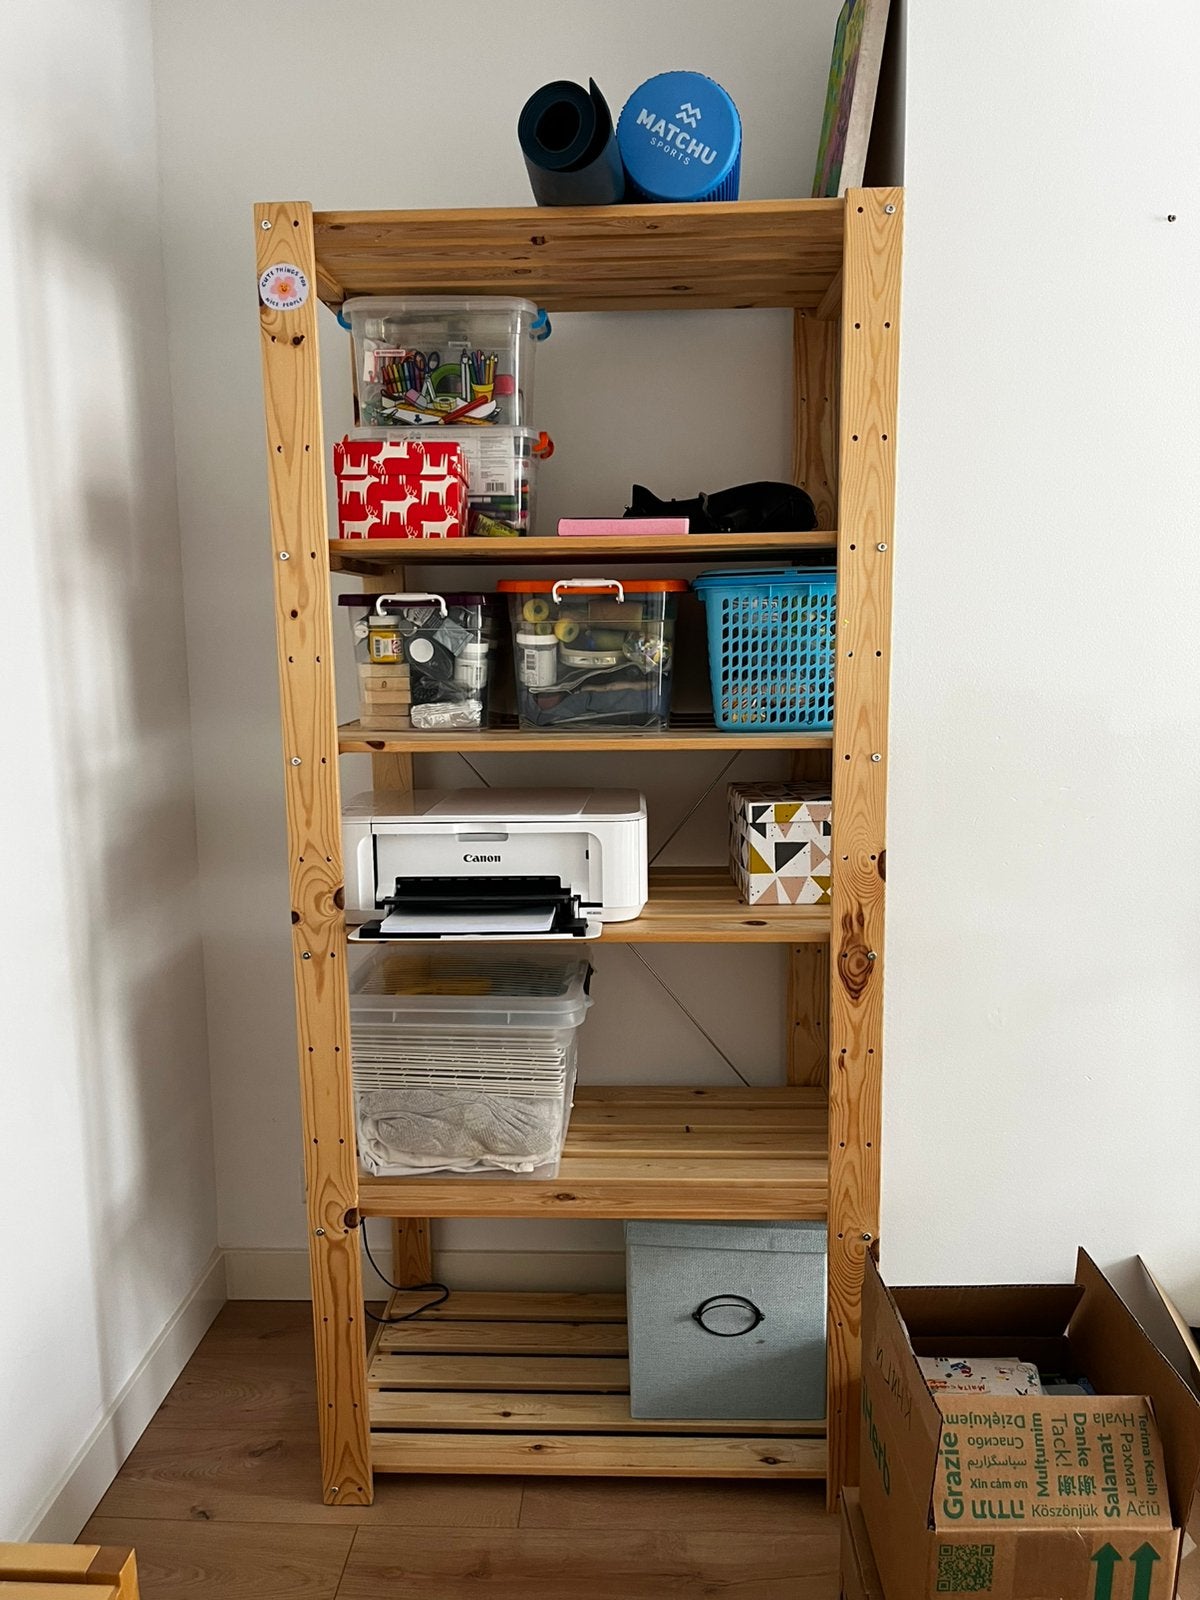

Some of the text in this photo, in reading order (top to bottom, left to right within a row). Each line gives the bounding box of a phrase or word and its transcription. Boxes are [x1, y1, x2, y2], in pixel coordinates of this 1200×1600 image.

[636, 108, 718, 165] MATCHU
[650, 137, 690, 166] SPORTS
[463, 854, 501, 862] Canon
[943, 1412, 1025, 1429] Dziękujem
[1093, 1412, 1134, 1427] Hvala
[967, 1436, 1024, 1449] Спасибо
[1051, 1413, 1072, 1467] Tack!
[1073, 1413, 1091, 1467] Danke
[1120, 1433, 1137, 1497] Рахмат
[1138, 1413, 1158, 1496] Terima Kasih
[938, 1432, 964, 1519] Grazie
[970, 1478, 987, 1488] Xin
[1058, 1475, 1096, 1496] 谢谢
[1097, 1433, 1121, 1518] Salamat
[971, 1500, 1025, 1519] תודה
[1031, 1503, 1098, 1519] Köszönjük
